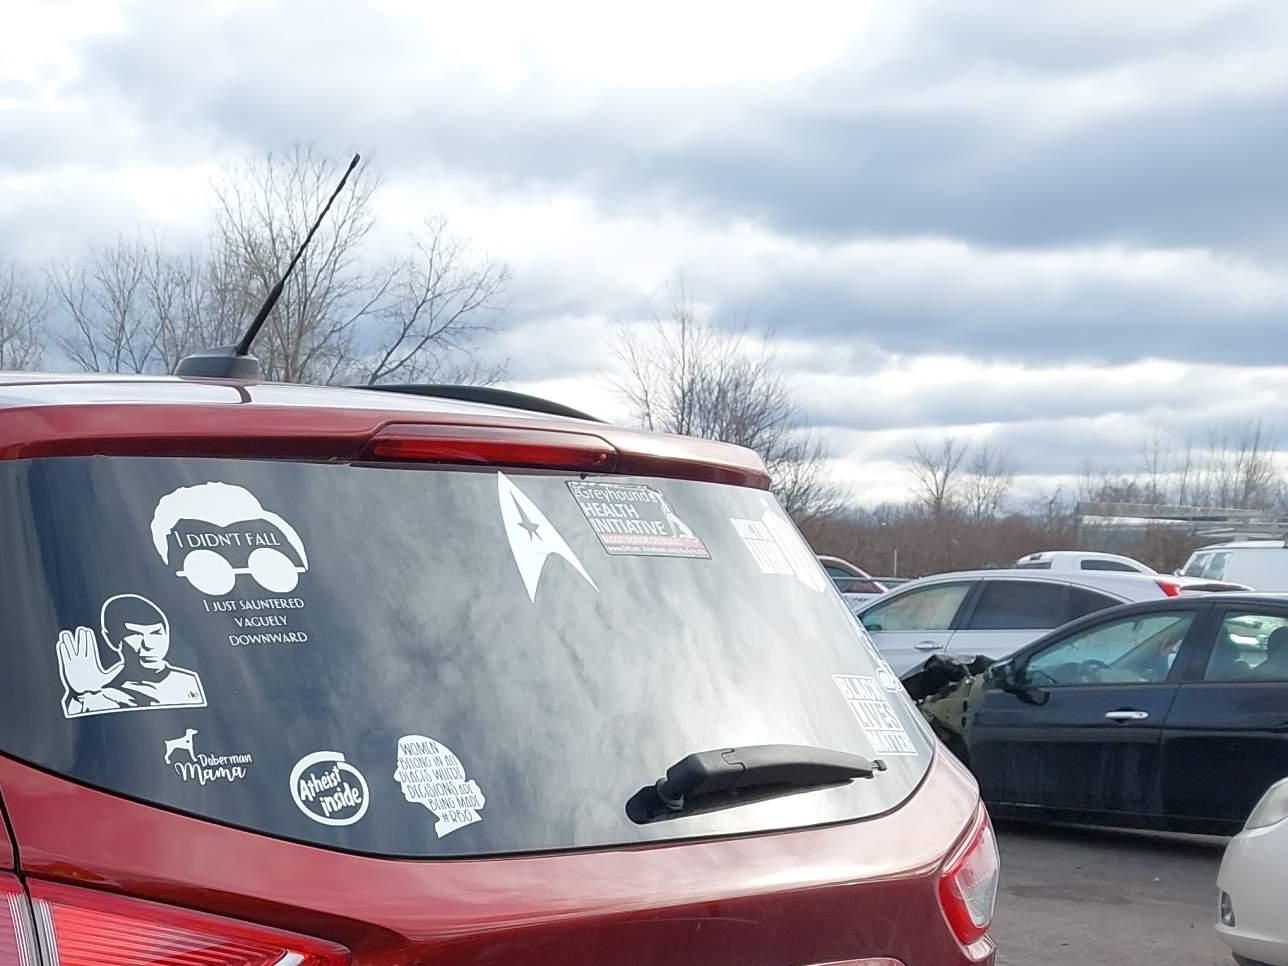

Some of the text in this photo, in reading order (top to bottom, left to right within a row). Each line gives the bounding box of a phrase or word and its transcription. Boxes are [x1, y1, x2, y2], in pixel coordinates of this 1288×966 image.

[579, 485, 650, 503] Greyhound
[580, 502, 640, 519] HEALTH
[589, 518, 668, 535] INITIATIVE
[174, 530, 281, 548] I DIDN'T FALL
[203, 598, 305, 612] I JUST SAUNTERED
[234, 615, 288, 628] VAGUELY
[228, 631, 308, 646] DOWNWARD
[849, 702, 902, 728] LIVES
[197, 753, 253, 767] Doberman
[174, 762, 247, 786] Mama
[299, 765, 342, 801] Atheist
[319, 782, 362, 817] inside
